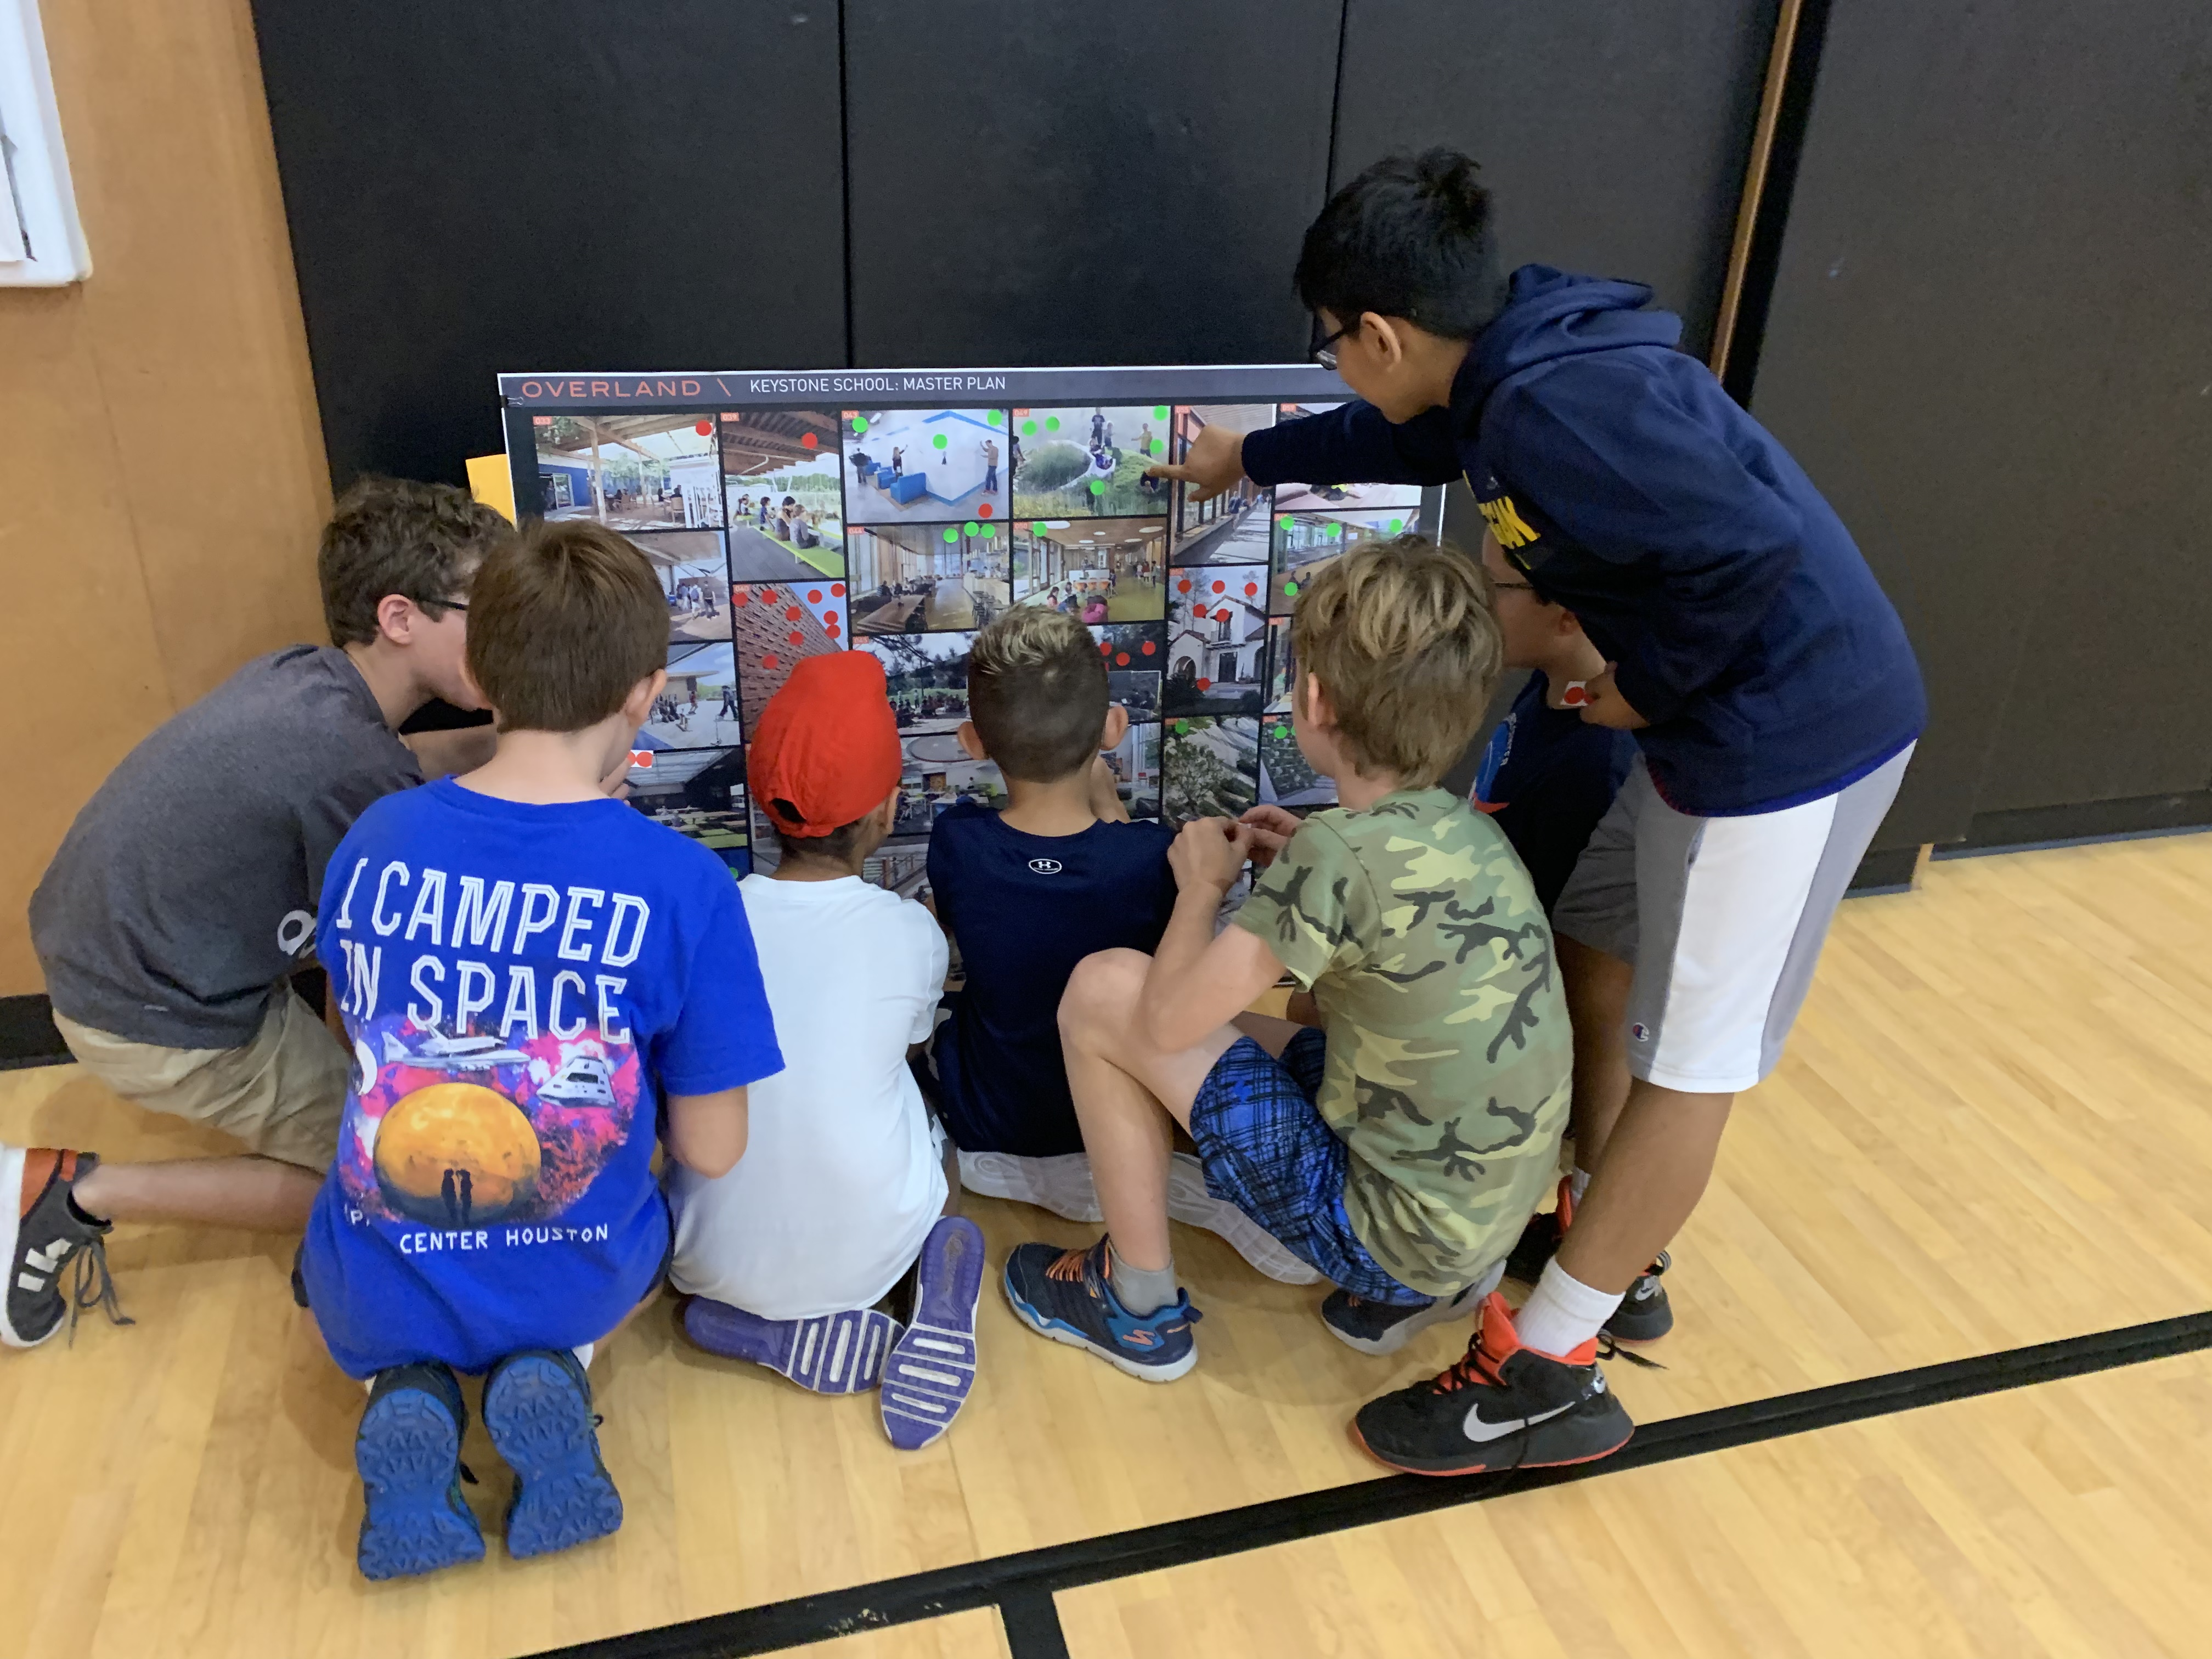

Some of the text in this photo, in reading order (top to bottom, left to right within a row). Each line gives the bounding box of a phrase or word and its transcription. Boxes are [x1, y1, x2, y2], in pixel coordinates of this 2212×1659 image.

[521, 380, 701, 398] OVERLAND
[749, 378, 830, 393] KEYSTONE
[833, 377, 899, 392] SCHOOL:
[904, 377, 963, 391] MASTER
[967, 376, 1006, 391] PLAN
[336, 857, 369, 929] I
[371, 860, 651, 968] CAMPED
[339, 939, 631, 1045] IN SPACE
[399, 1222, 609, 1254] CENTER HOUSTON
